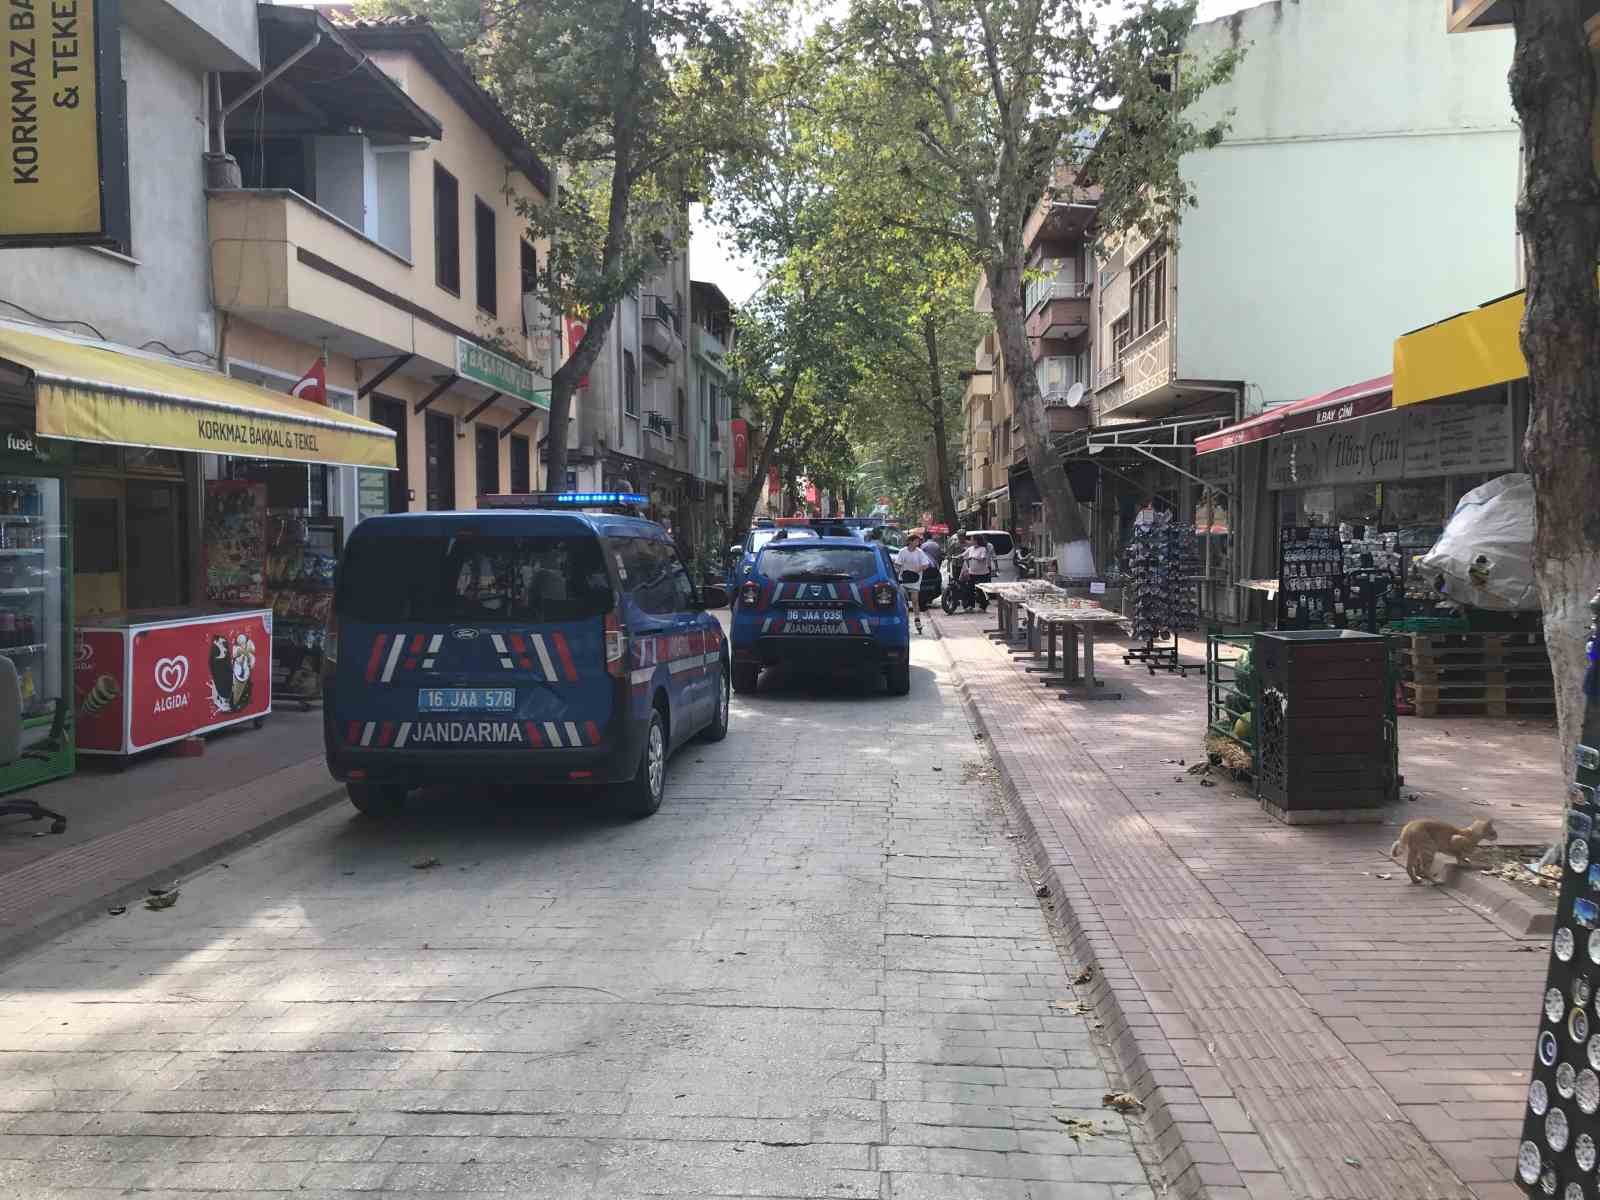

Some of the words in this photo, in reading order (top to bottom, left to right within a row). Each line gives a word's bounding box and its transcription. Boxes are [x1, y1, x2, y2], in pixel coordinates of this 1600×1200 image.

[53, 86, 79, 109] &
[10, 38, 39, 184] KORKMAZ
[8, 433, 33, 451] fuse
[198, 419, 247, 444] KORKMAZ
[249, 427, 284, 448] BAKKAL
[285, 431, 293, 448] &
[293, 432, 319, 452] TEKEL
[802, 611, 820, 620] JAA
[153, 693, 188, 713] ALGIDA
[429, 691, 443, 707] 16
[450, 691, 477, 707] JAA
[485, 691, 513, 707] 578
[412, 722, 522, 742] JANDARMA
